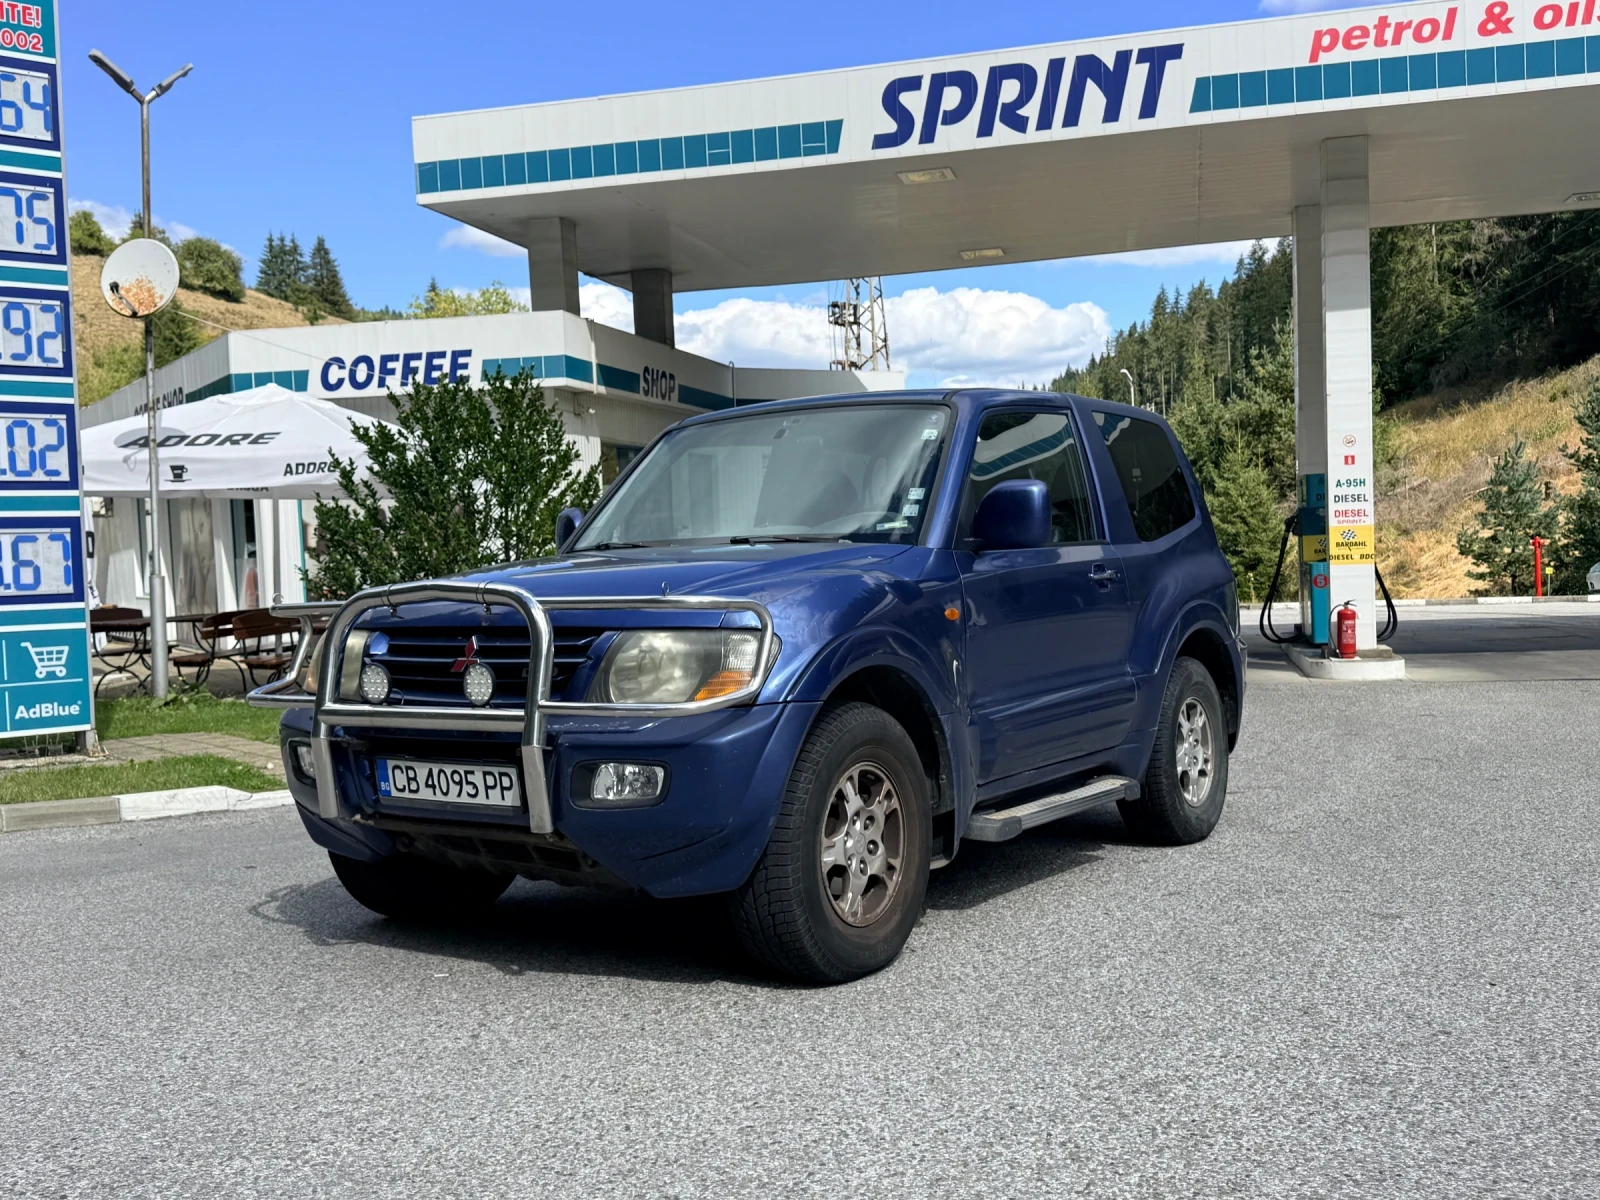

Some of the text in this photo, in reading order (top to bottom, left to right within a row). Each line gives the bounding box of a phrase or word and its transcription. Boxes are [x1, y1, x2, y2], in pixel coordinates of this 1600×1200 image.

[1309, 0, 1600, 63] petrol & oil
[872, 43, 1184, 150] SPRINT
[0, 302, 62, 363] 92
[321, 349, 472, 392] COFFEE
[642, 366, 676, 401] SHOP
[1334, 494, 1369, 503] DIESEL
[1334, 509, 1369, 518] DIESEL
[381, 764, 514, 801] BG CB 4095 PP
